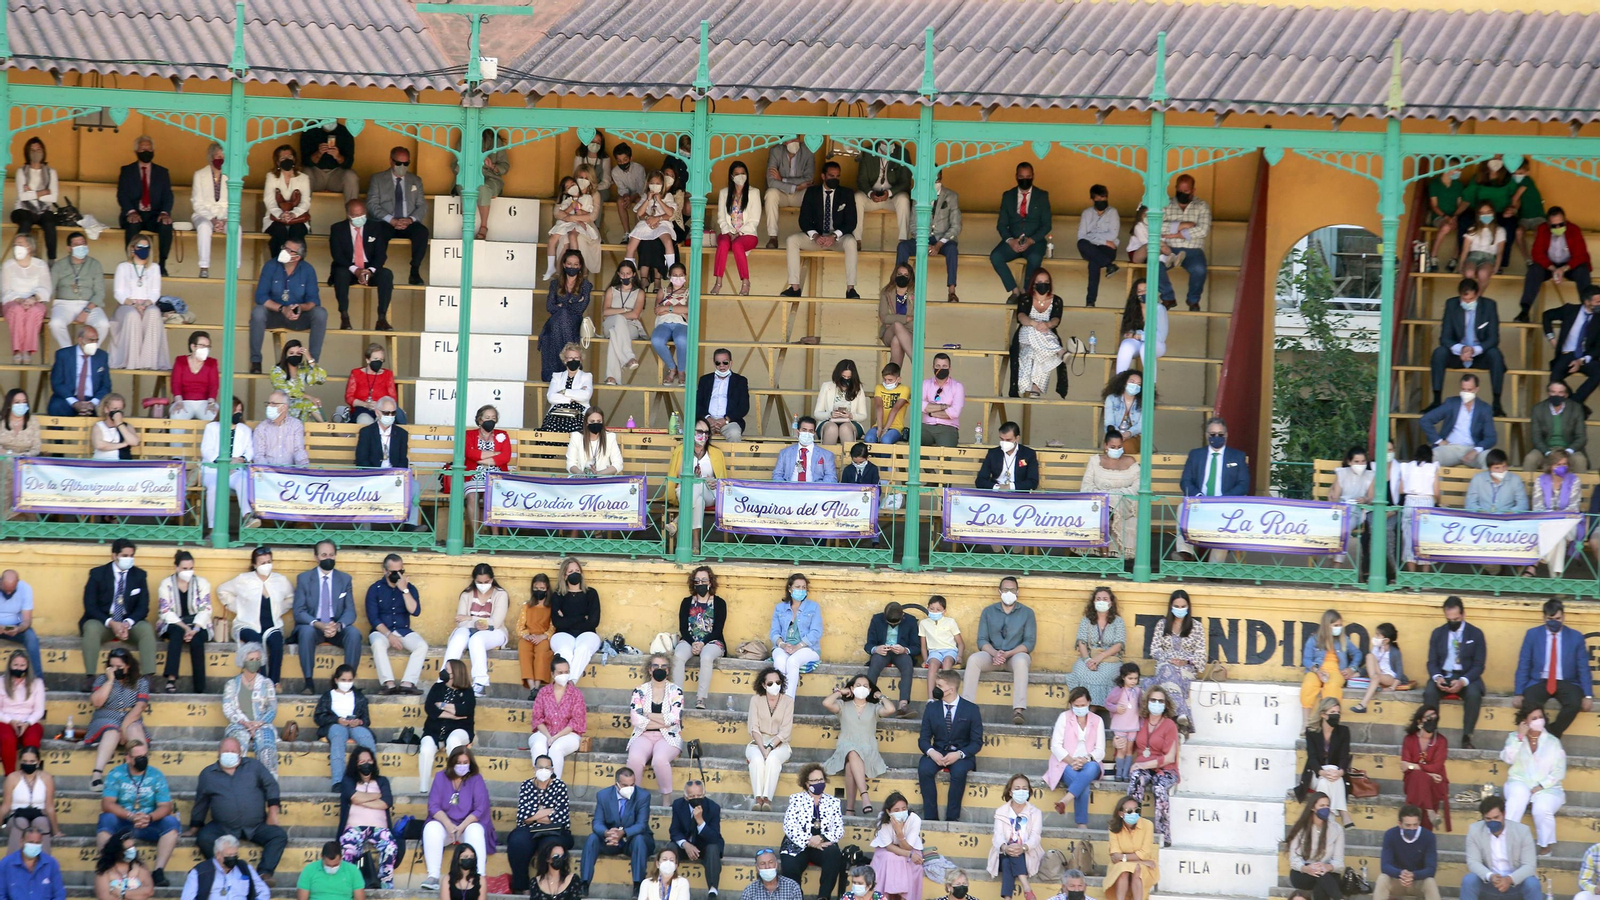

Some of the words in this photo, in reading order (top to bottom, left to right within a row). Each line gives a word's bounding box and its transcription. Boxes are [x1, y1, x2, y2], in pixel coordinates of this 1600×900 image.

[448, 203, 462, 215] FI
[508, 205, 517, 217] 6
[444, 247, 463, 259] FIL
[506, 250, 515, 261] 5
[438, 295, 458, 307] FIL
[500, 296, 508, 308] 4
[493, 389, 501, 401] 2
[750, 444, 760, 452] 69
[25, 476, 45, 491] De
[47, 477, 58, 490] la
[60, 478, 125, 495] Albarizuela
[127, 482, 138, 493] al
[141, 479, 175, 493] Rocío
[278, 480, 300, 501] El
[305, 478, 382, 508] Ángelus
[501, 490, 518, 508] El
[520, 491, 574, 511] Cordón
[578, 493, 631, 513] Morao
[734, 495, 794, 518] Suspiros
[796, 502, 818, 517] del
[821, 500, 861, 519] Alba
[966, 503, 1008, 527] Los
[1012, 504, 1086, 528] Primos
[1217, 508, 1254, 534] La
[1260, 510, 1311, 536] Roá
[1441, 521, 1466, 545] El
[1470, 523, 1540, 552] Trasieg
[1134, 613, 1370, 669] TNDIO
[47, 651, 68, 663] 24
[209, 653, 230, 667] 27
[316, 656, 335, 669] 29
[1210, 693, 1241, 706] FILA
[187, 703, 207, 716] 25
[402, 705, 421, 718] 29
[612, 715, 632, 729] 33
[1213, 711, 1234, 725] 46
[1274, 713, 1279, 726] 1
[1199, 756, 1230, 770] FILA
[1255, 758, 1270, 771] 12
[1188, 809, 1220, 823] FILA
[1245, 810, 1257, 824] 11
[1179, 860, 1211, 874] FILA
[1235, 862, 1251, 876] 10
